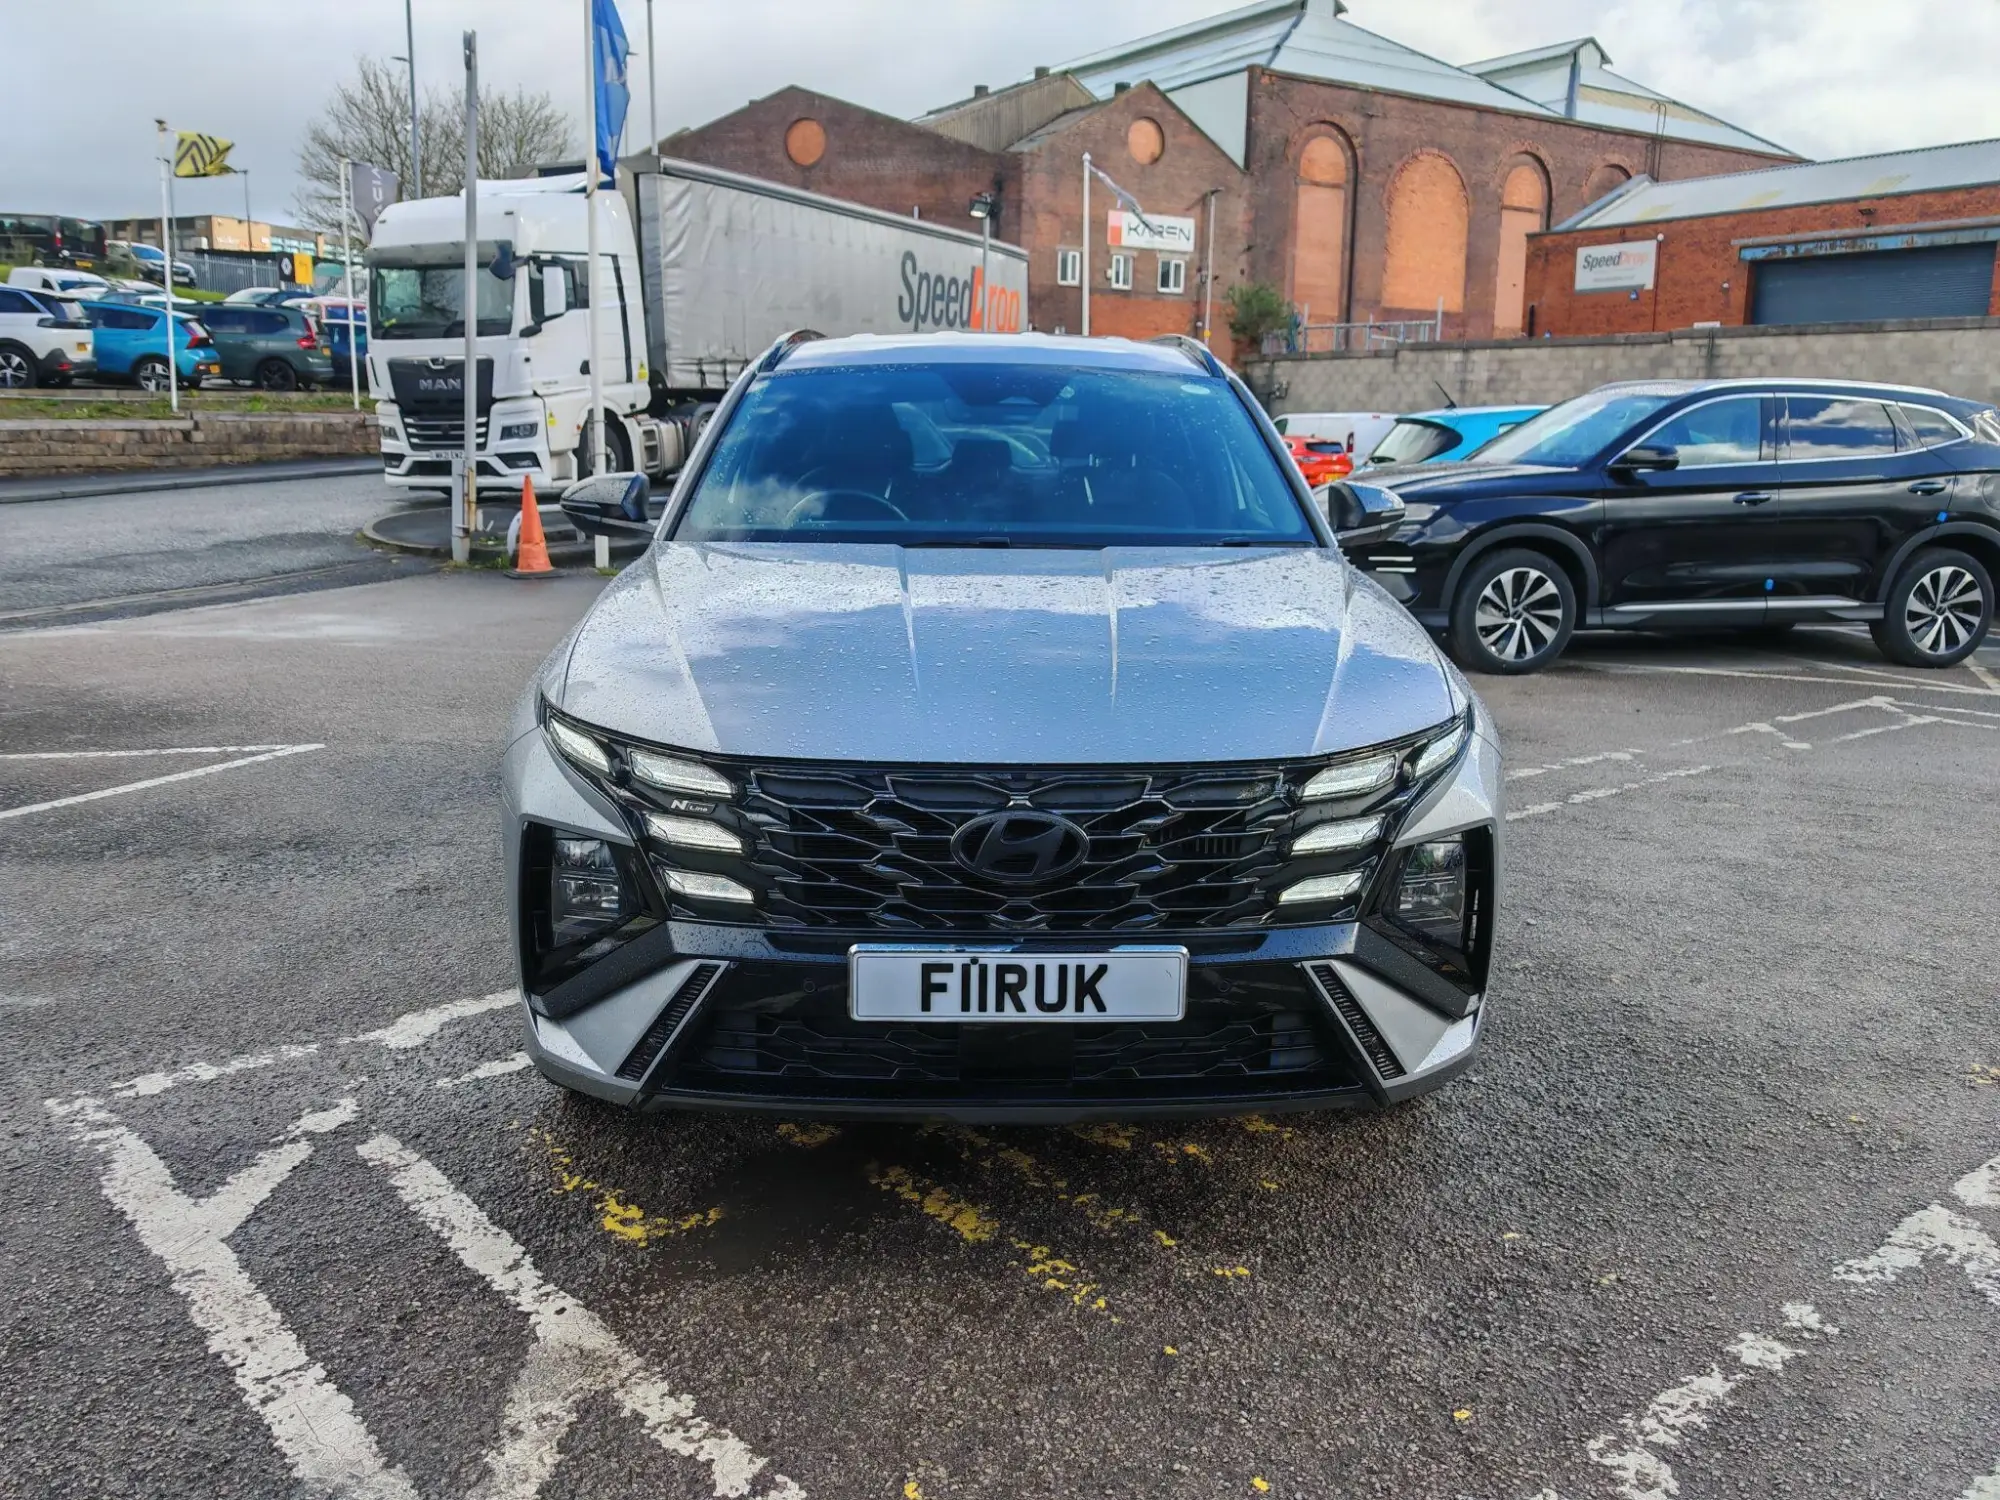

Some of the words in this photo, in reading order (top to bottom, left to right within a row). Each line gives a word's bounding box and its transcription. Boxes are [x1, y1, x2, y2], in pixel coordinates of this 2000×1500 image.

[419, 378, 461, 390] MAN
[670, 799, 688, 810] N
[921, 963, 1108, 1013] F11RUK
